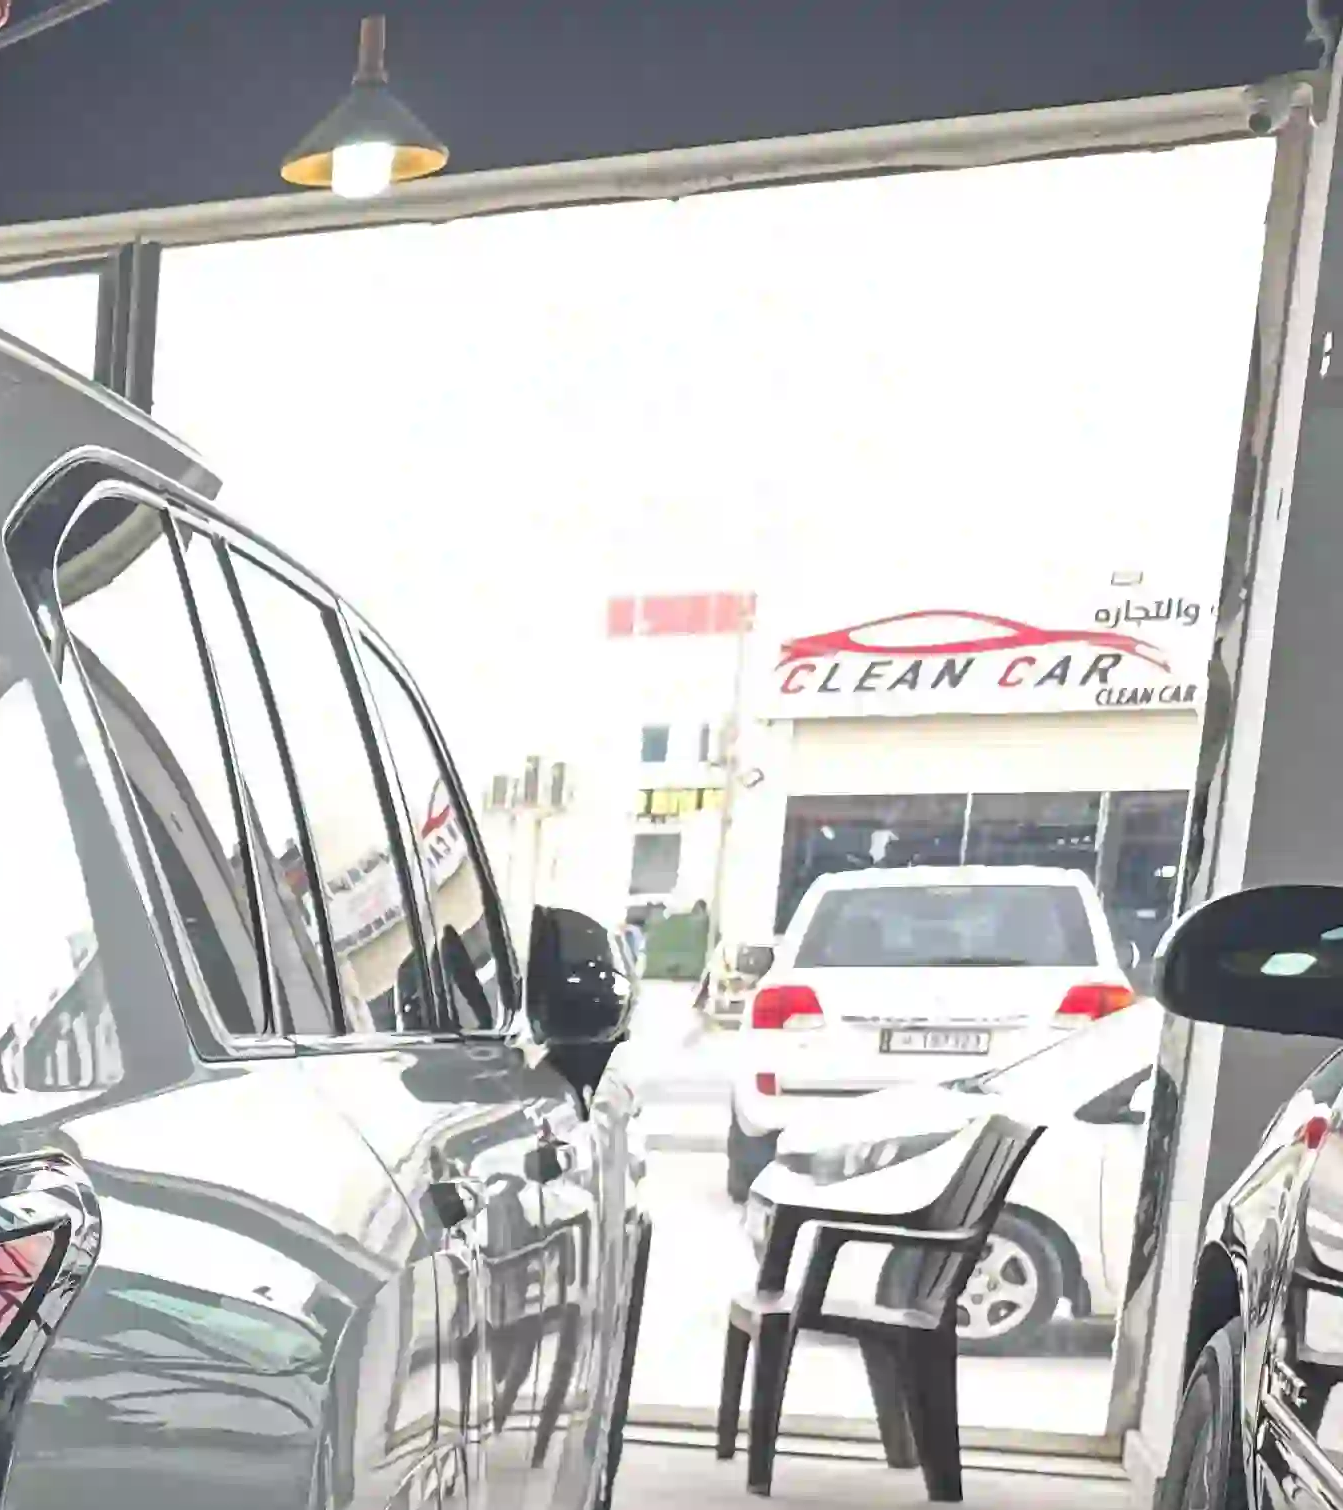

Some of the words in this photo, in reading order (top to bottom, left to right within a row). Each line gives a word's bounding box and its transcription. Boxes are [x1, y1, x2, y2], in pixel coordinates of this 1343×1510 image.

[780, 656, 975, 694] CLEAN
[998, 653, 1122, 687] CAR
[1095, 687, 1154, 705] CLEAN
[1158, 684, 1198, 702] CAR
